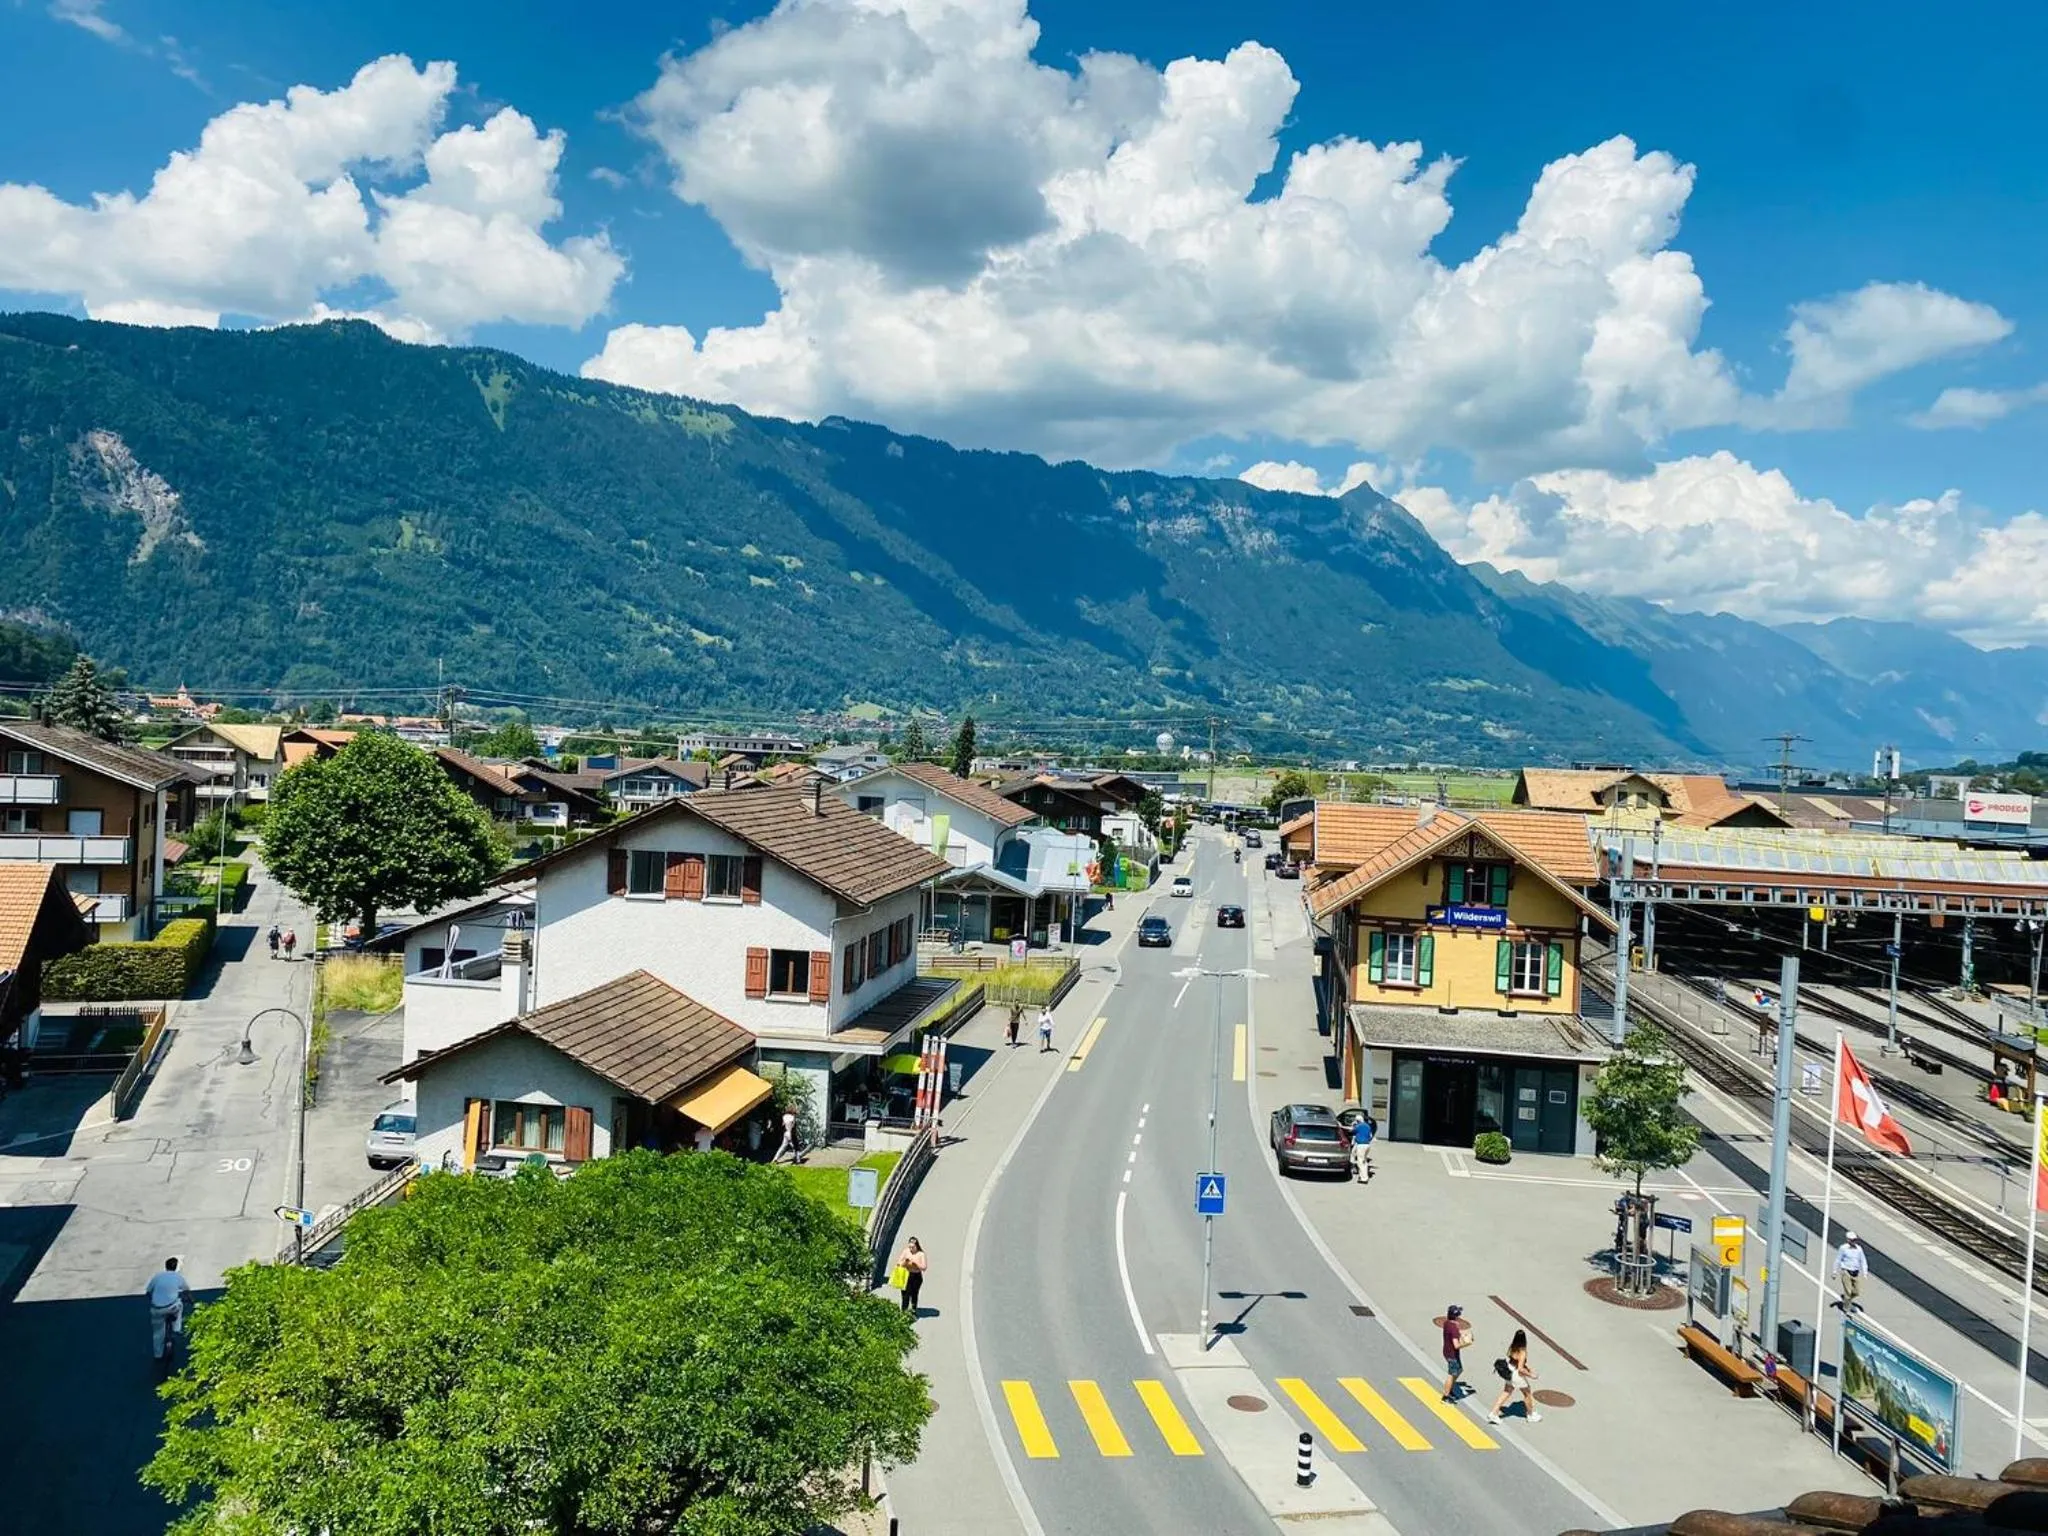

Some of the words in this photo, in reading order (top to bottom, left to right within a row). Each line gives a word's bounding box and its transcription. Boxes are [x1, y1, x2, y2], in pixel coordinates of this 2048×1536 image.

[1987, 803, 2029, 813] PRODEGA
[1453, 911, 1502, 923] Wilderswil
[215, 1157, 252, 1174] 30
[1725, 1247, 1735, 1263] C
